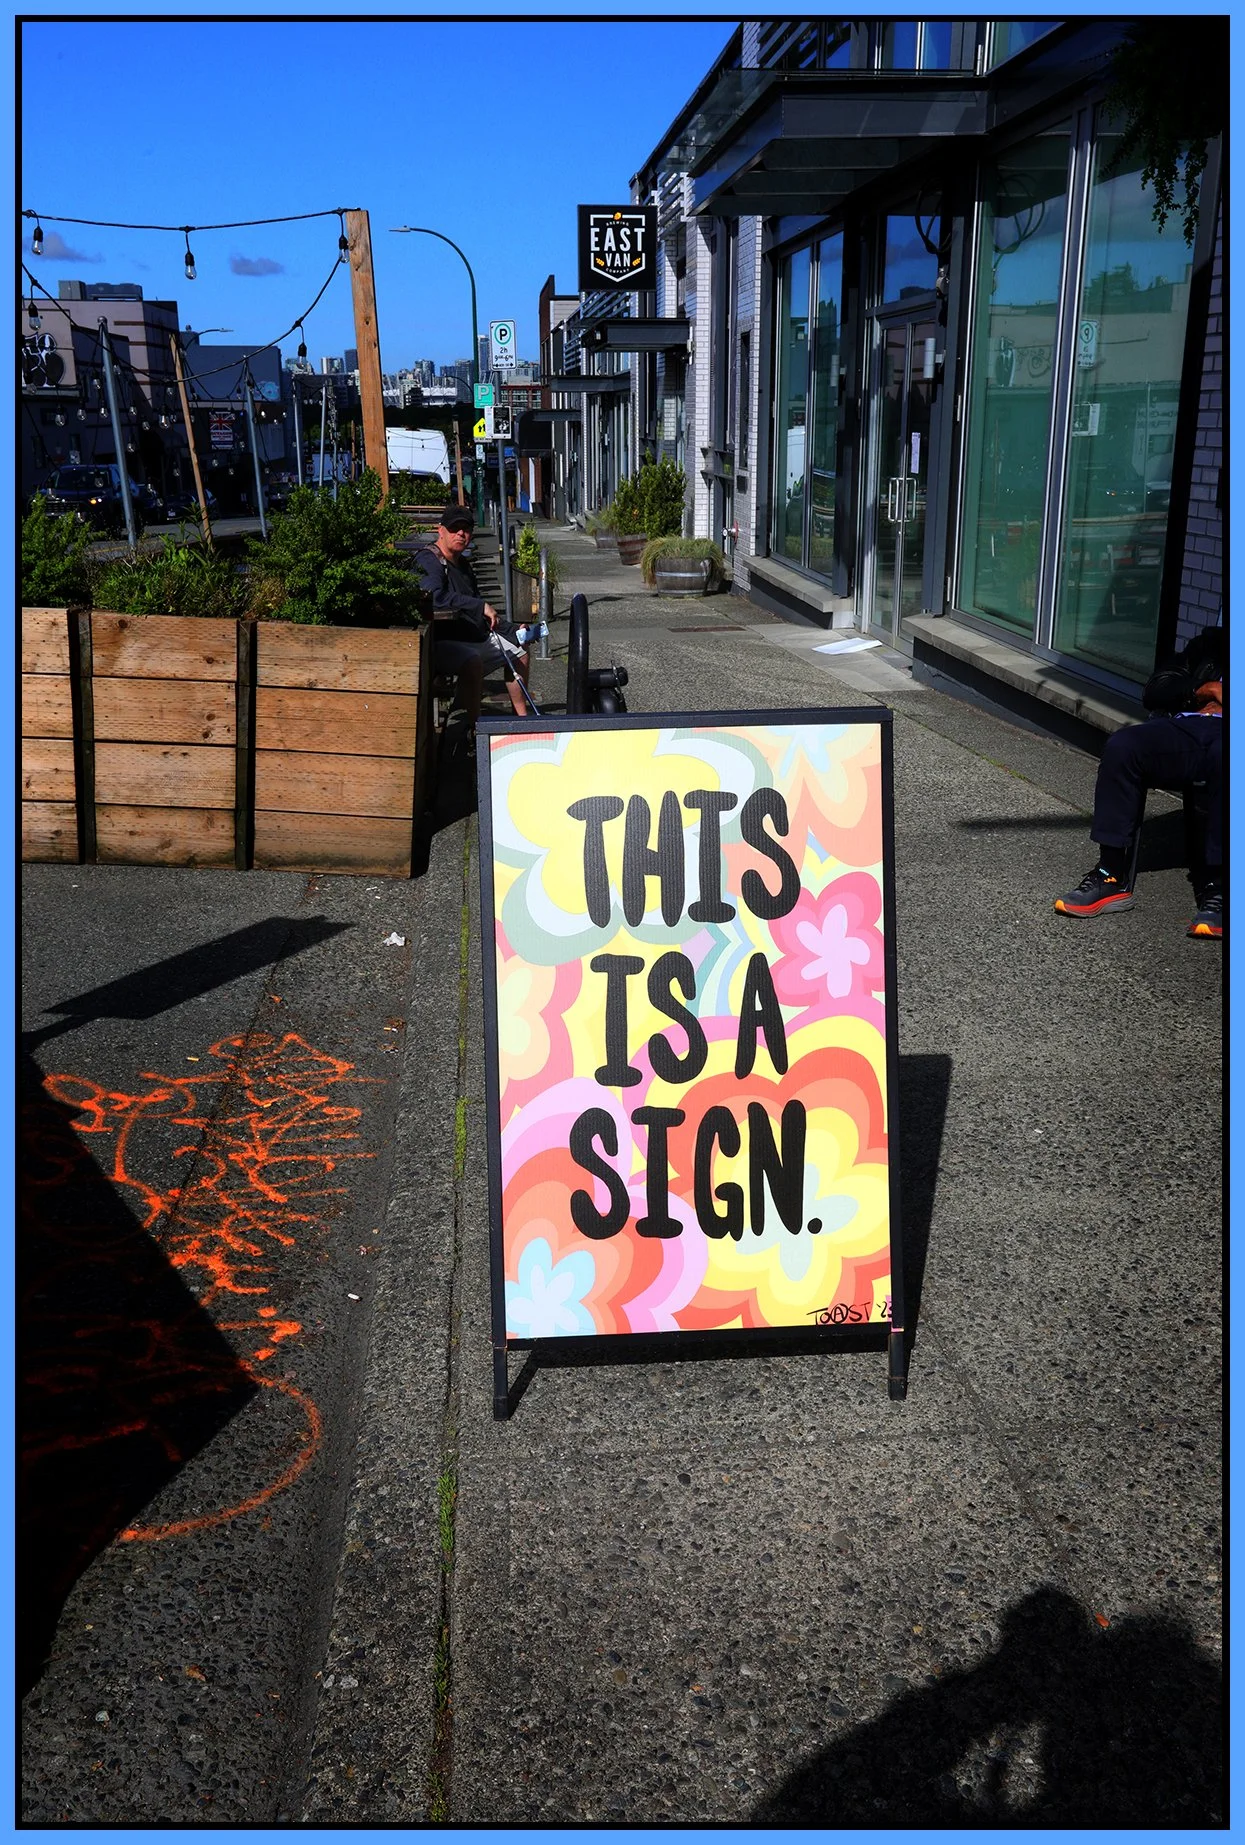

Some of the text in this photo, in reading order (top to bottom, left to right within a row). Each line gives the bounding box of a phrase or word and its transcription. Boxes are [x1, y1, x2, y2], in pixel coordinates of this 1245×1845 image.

[590, 227, 646, 252] EAST
[605, 252, 631, 267] VAN
[499, 328, 508, 341] P
[477, 385, 490, 400] P
[567, 787, 801, 930] THIS
[590, 951, 789, 1088] IS A
[569, 1100, 823, 1242] SIGN.
